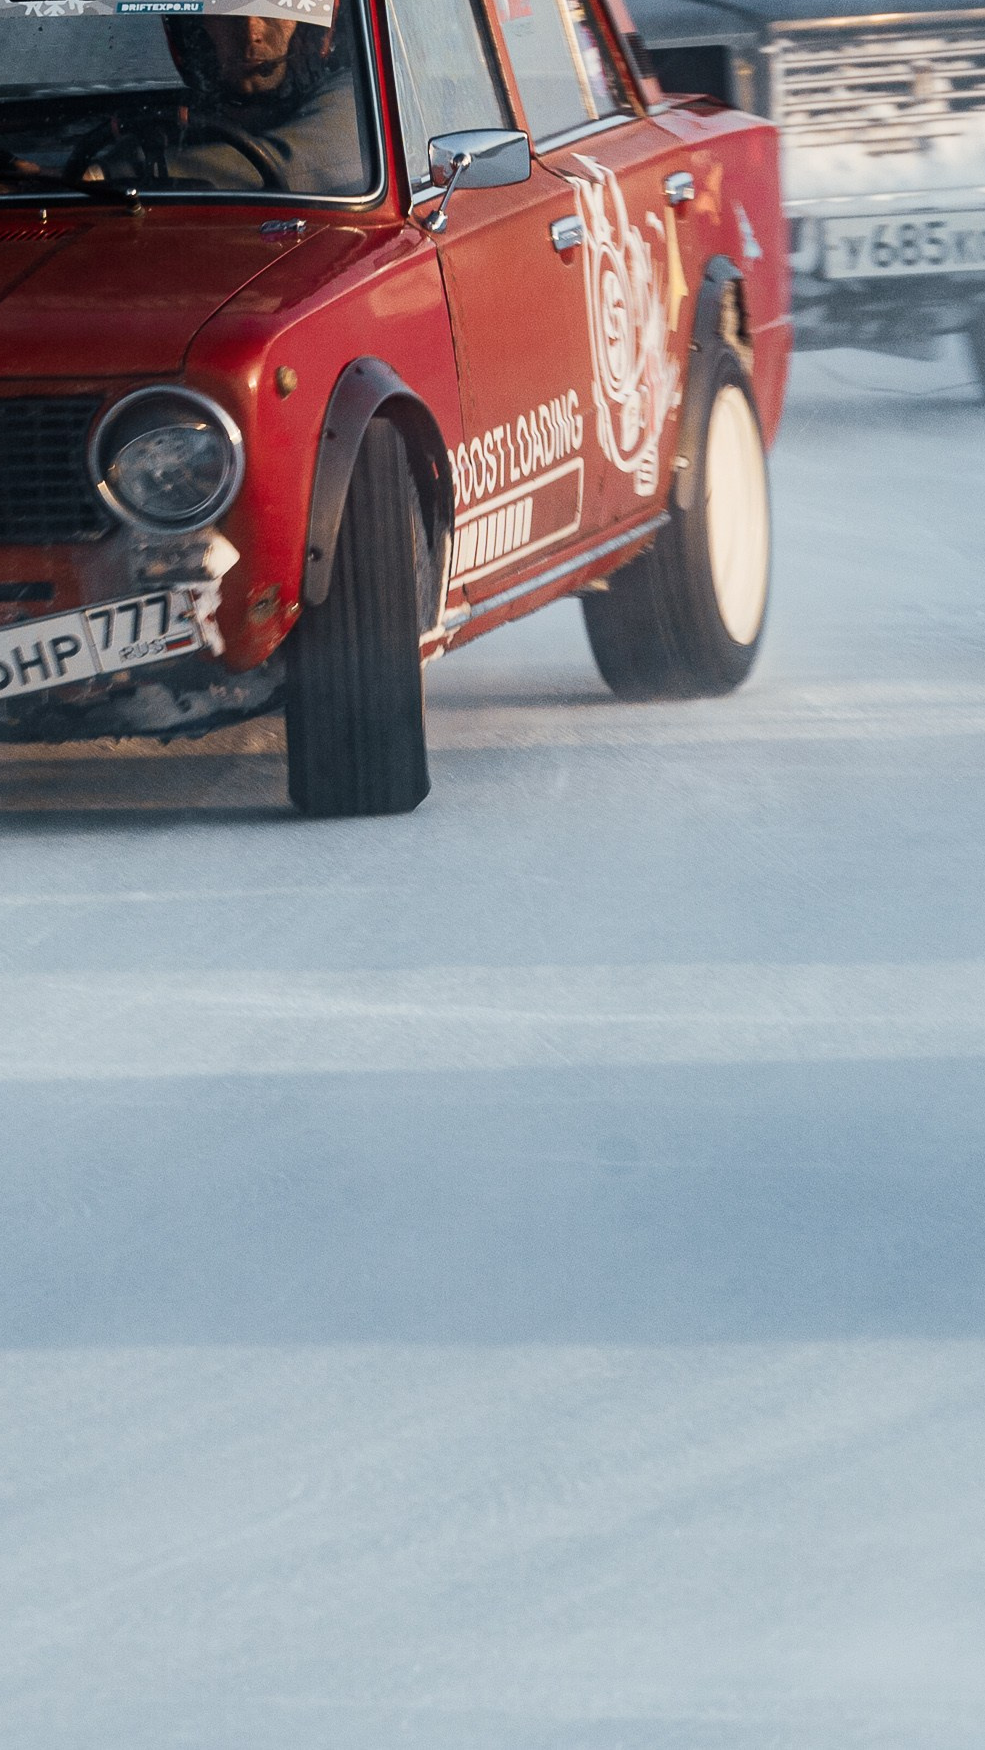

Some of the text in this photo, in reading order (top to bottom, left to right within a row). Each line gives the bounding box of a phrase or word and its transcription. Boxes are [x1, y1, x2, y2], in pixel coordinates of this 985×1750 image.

[121, 3, 199, 12] DRIFTEXPO.RU
[505, 388, 584, 482] LOADING
[88, 592, 173, 650] 777
[118, 636, 168, 663] RUS
